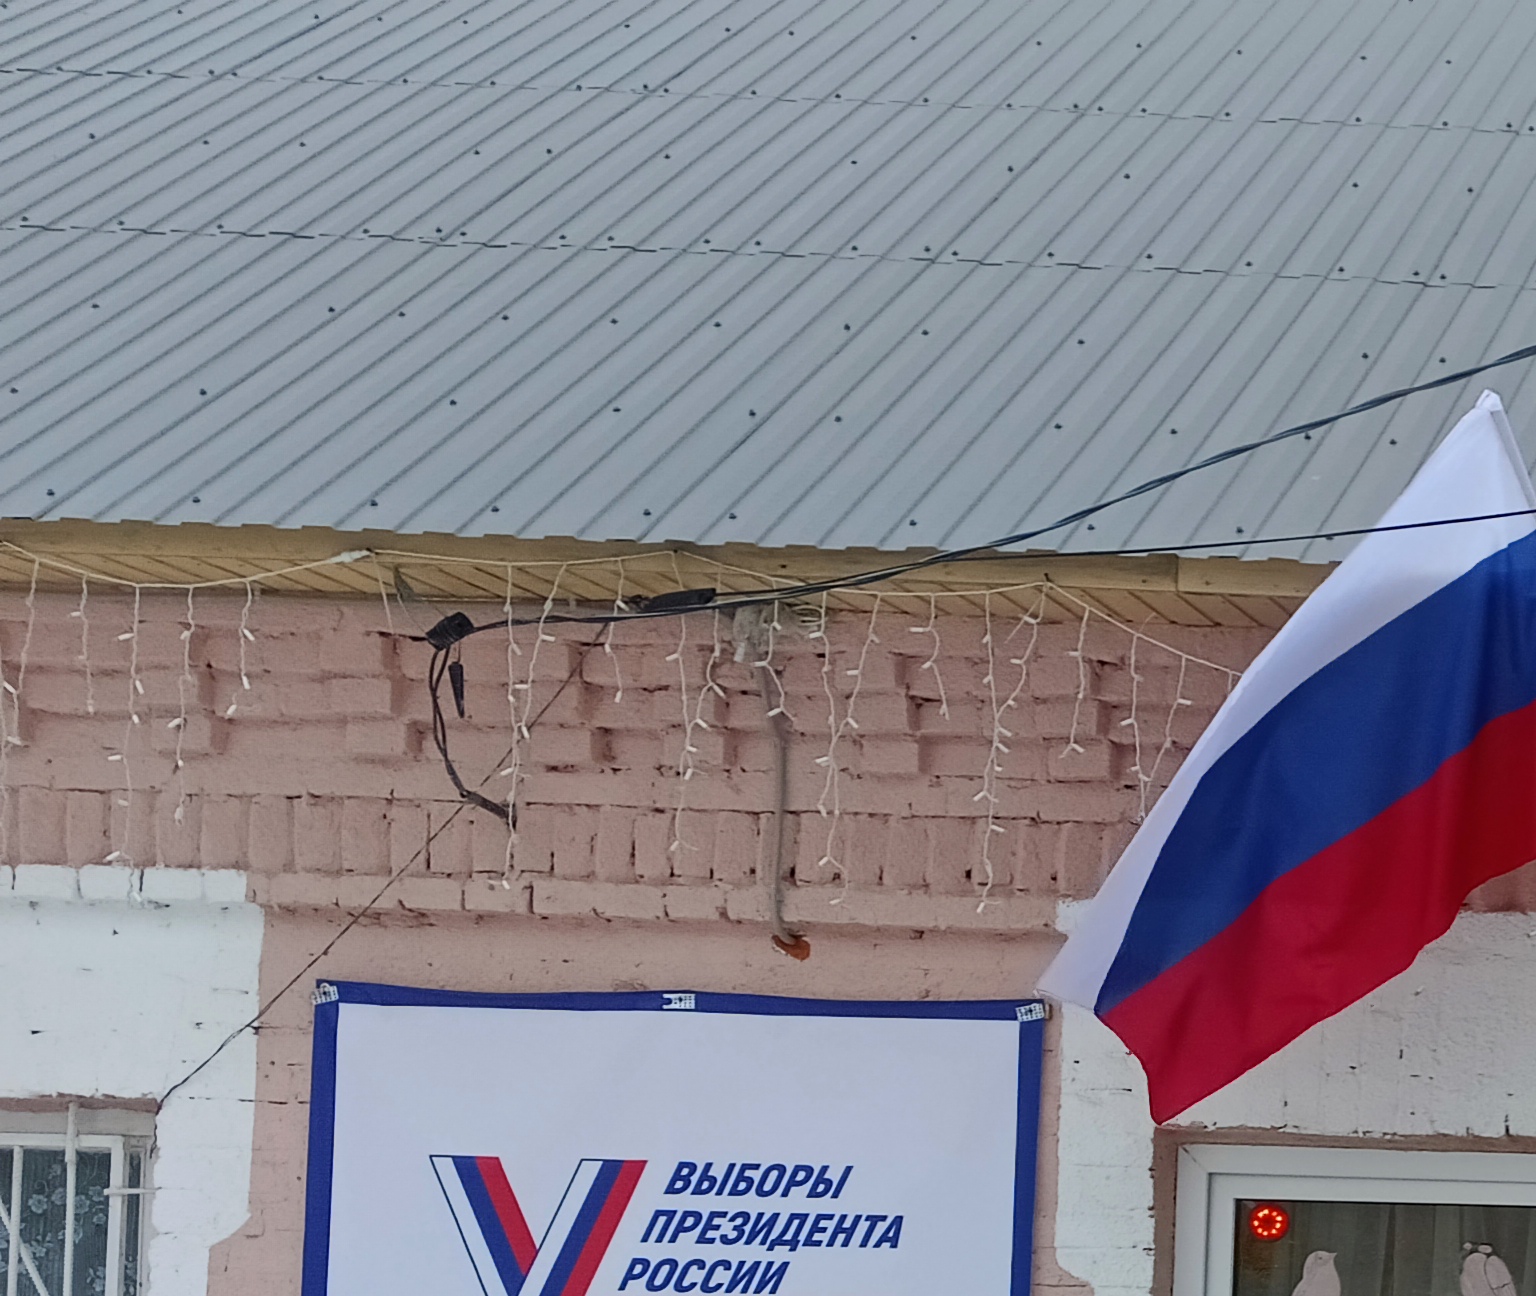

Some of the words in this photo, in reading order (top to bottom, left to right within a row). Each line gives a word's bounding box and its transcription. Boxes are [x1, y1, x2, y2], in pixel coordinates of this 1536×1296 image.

[663, 1160, 855, 1200] ВЫБОРЫ
[639, 1208, 904, 1252] ПРЕЗИДЕНТА
[617, 1257, 790, 1295] РОССИИ
